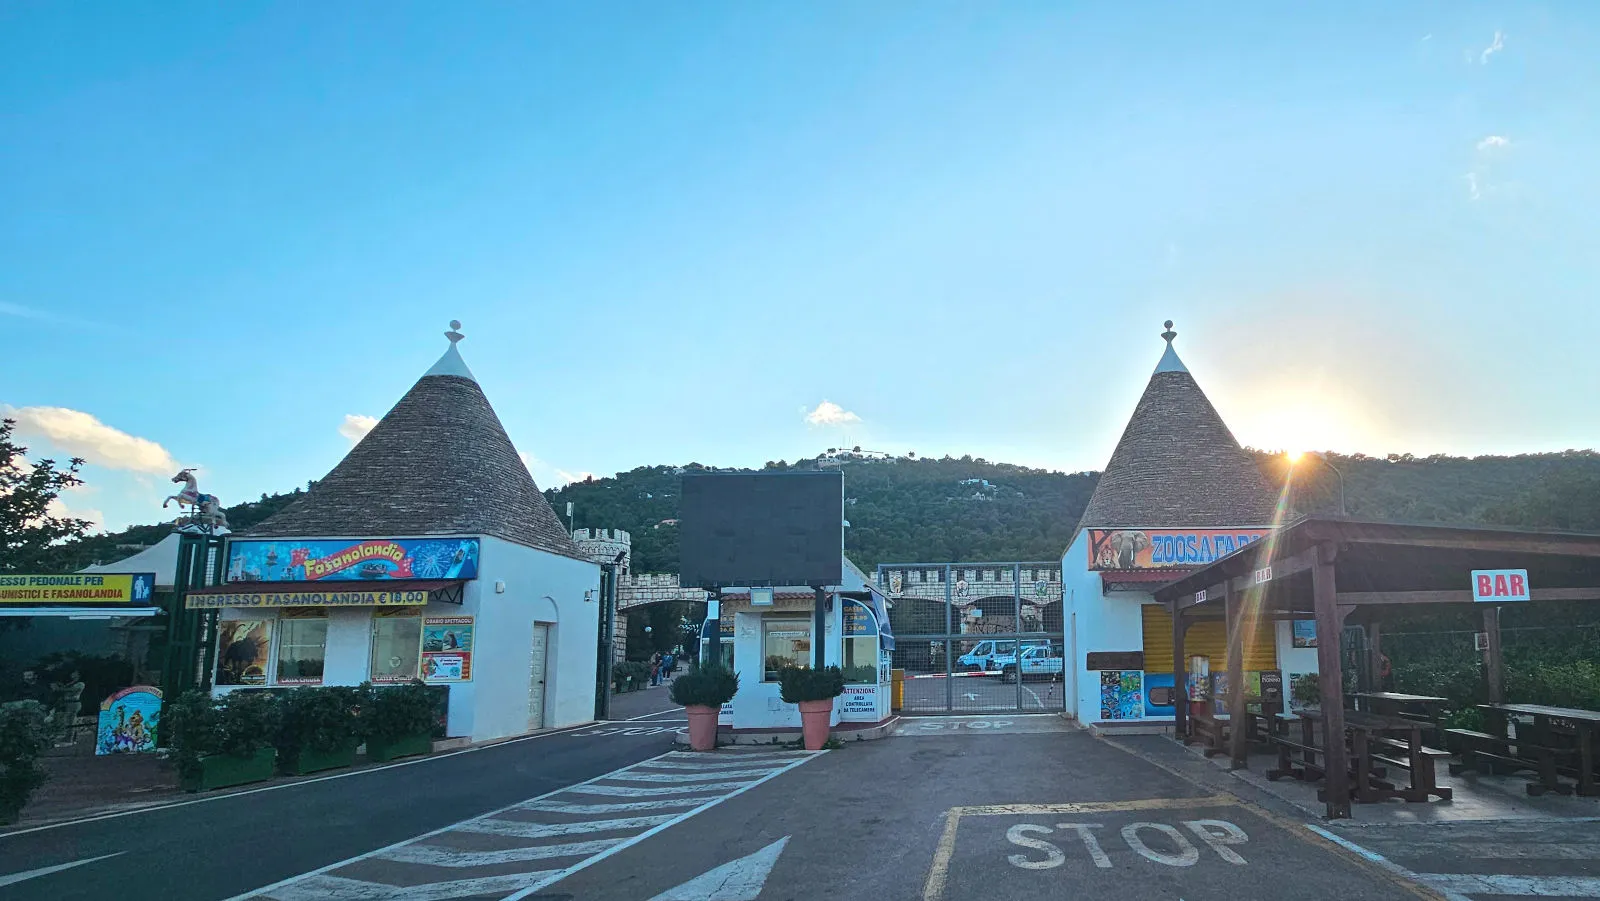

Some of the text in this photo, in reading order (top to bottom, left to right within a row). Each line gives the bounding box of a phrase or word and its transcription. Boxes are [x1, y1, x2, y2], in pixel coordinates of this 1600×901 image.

[303, 543, 404, 578] Fasanolandia
[29, 576, 82, 586] PEDONALE
[84, 576, 104, 586] PER
[1257, 568, 1271, 584] BAR
[1477, 574, 1525, 597] BAR
[0, 589, 123, 599] UNISTICI E FASANOLANDIA
[189, 595, 262, 607] INGRESSO
[264, 593, 375, 606] FASANOLANDIA
[920, 721, 1014, 730] STOP
[1006, 819, 1248, 870] STOP
